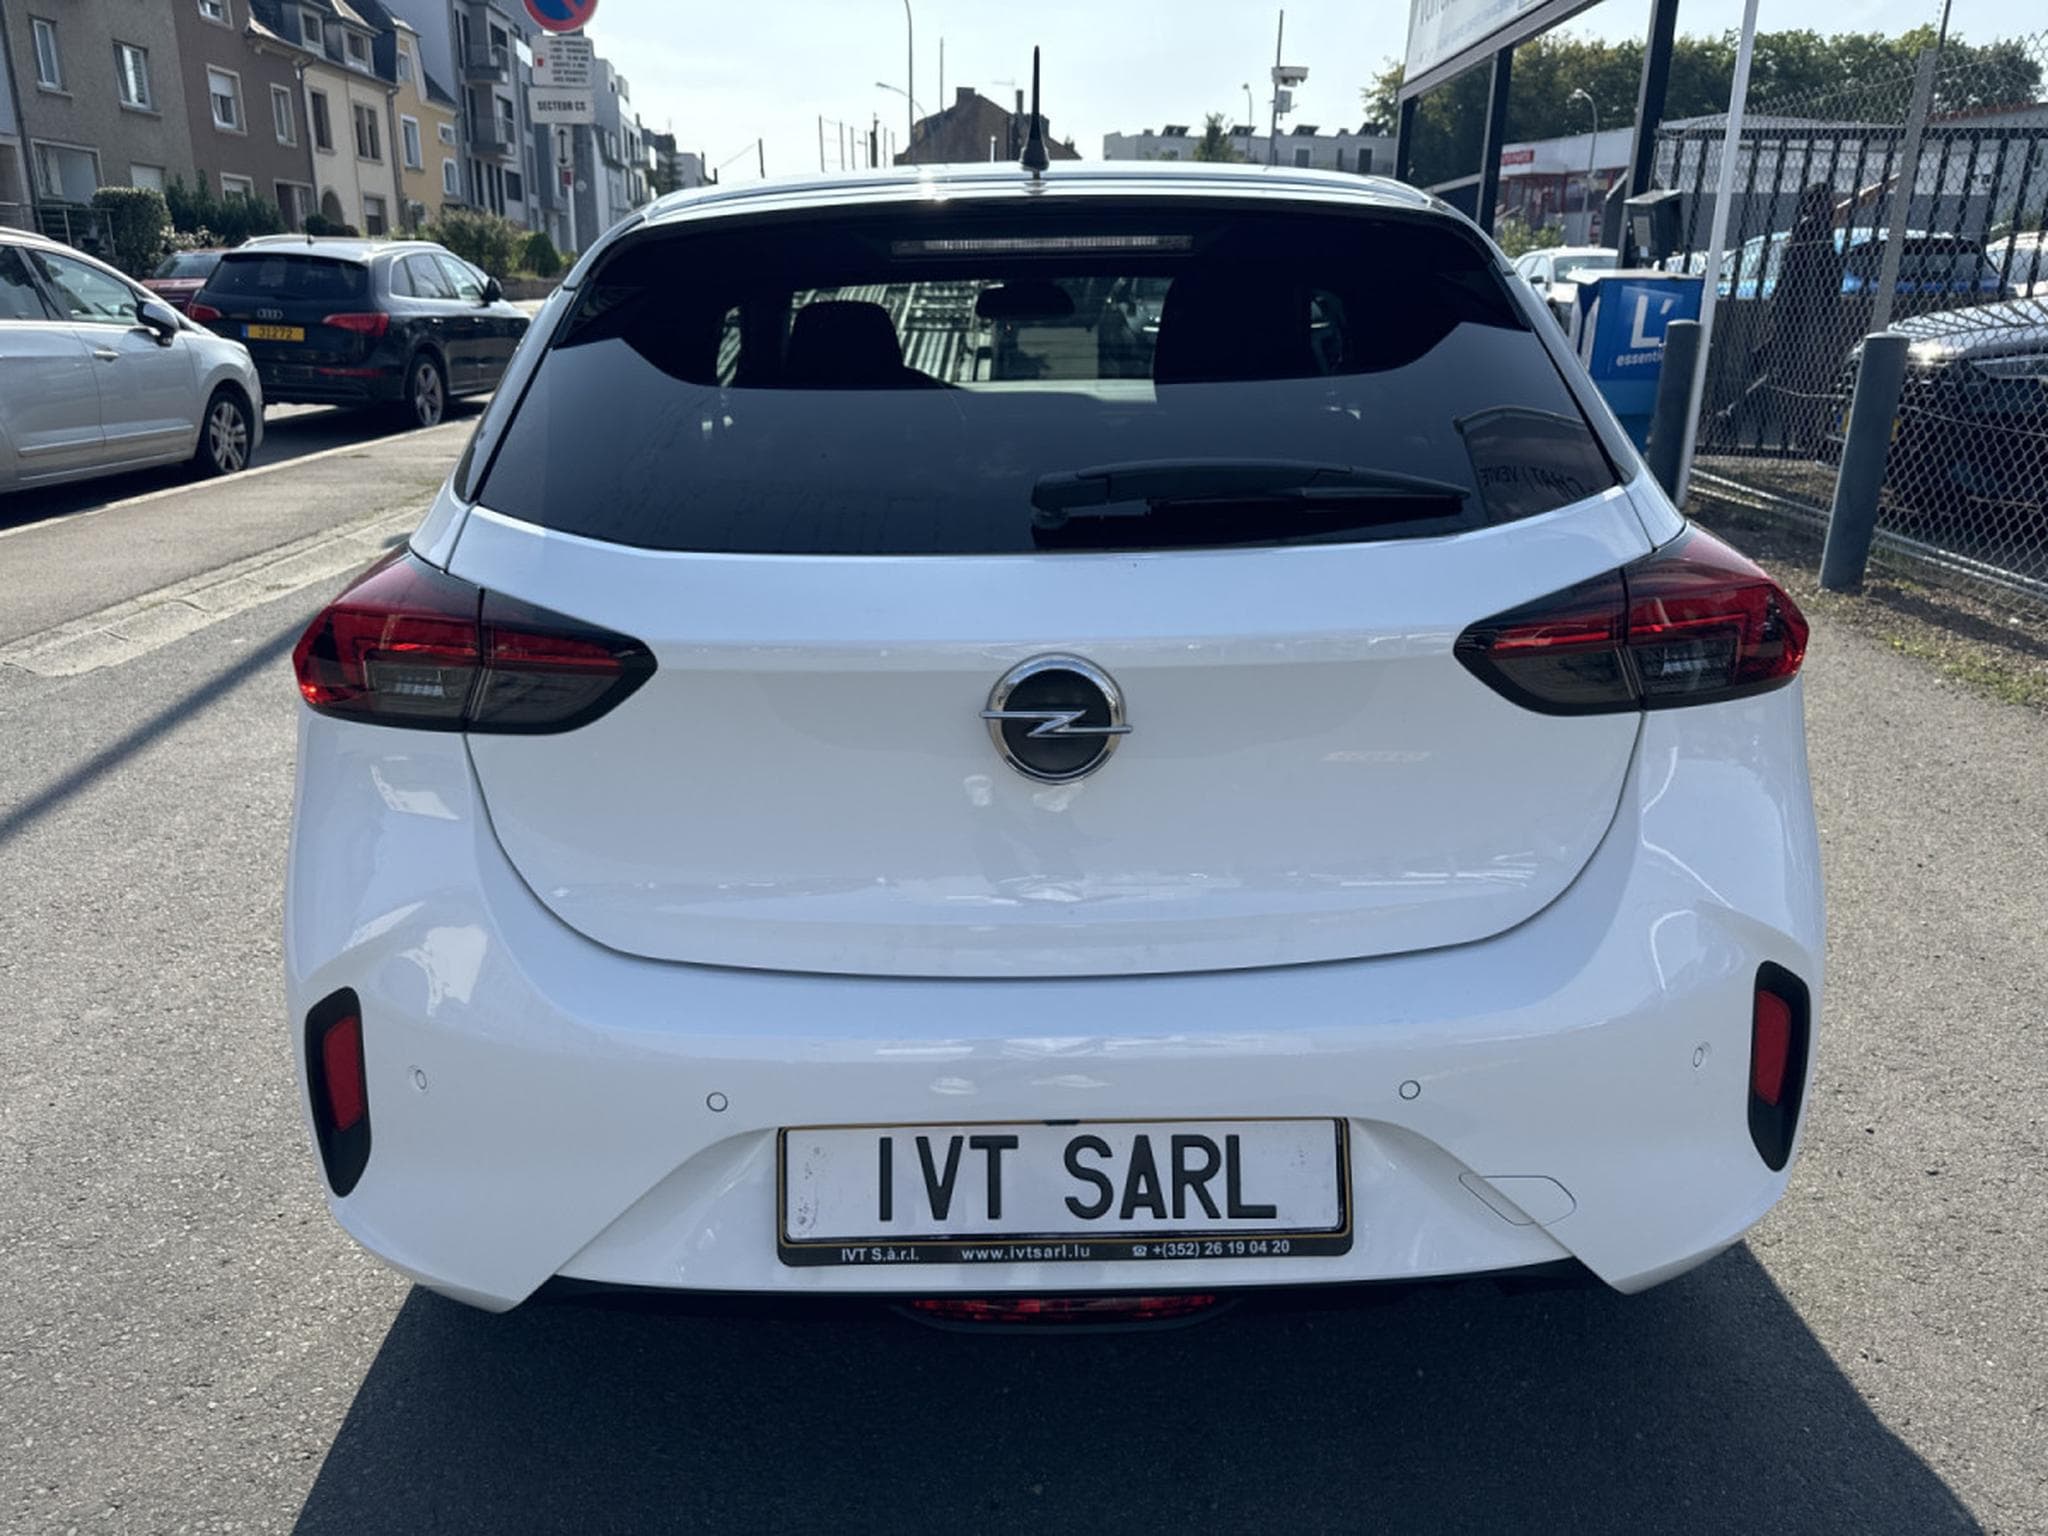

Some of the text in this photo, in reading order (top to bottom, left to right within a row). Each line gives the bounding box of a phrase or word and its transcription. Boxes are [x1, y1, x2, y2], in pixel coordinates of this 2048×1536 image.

[879, 1134, 1277, 1222] IVT SARL
[841, 1248, 867, 1262] IVT
[961, 1245, 1091, 1260] www.ivtsarl.lu
[1152, 1242, 1199, 1259] +(352)
[1204, 1242, 1222, 1256] 26
[1228, 1242, 1246, 1255] 19
[1249, 1241, 1268, 1254] 04
[1271, 1240, 1290, 1254] 20
